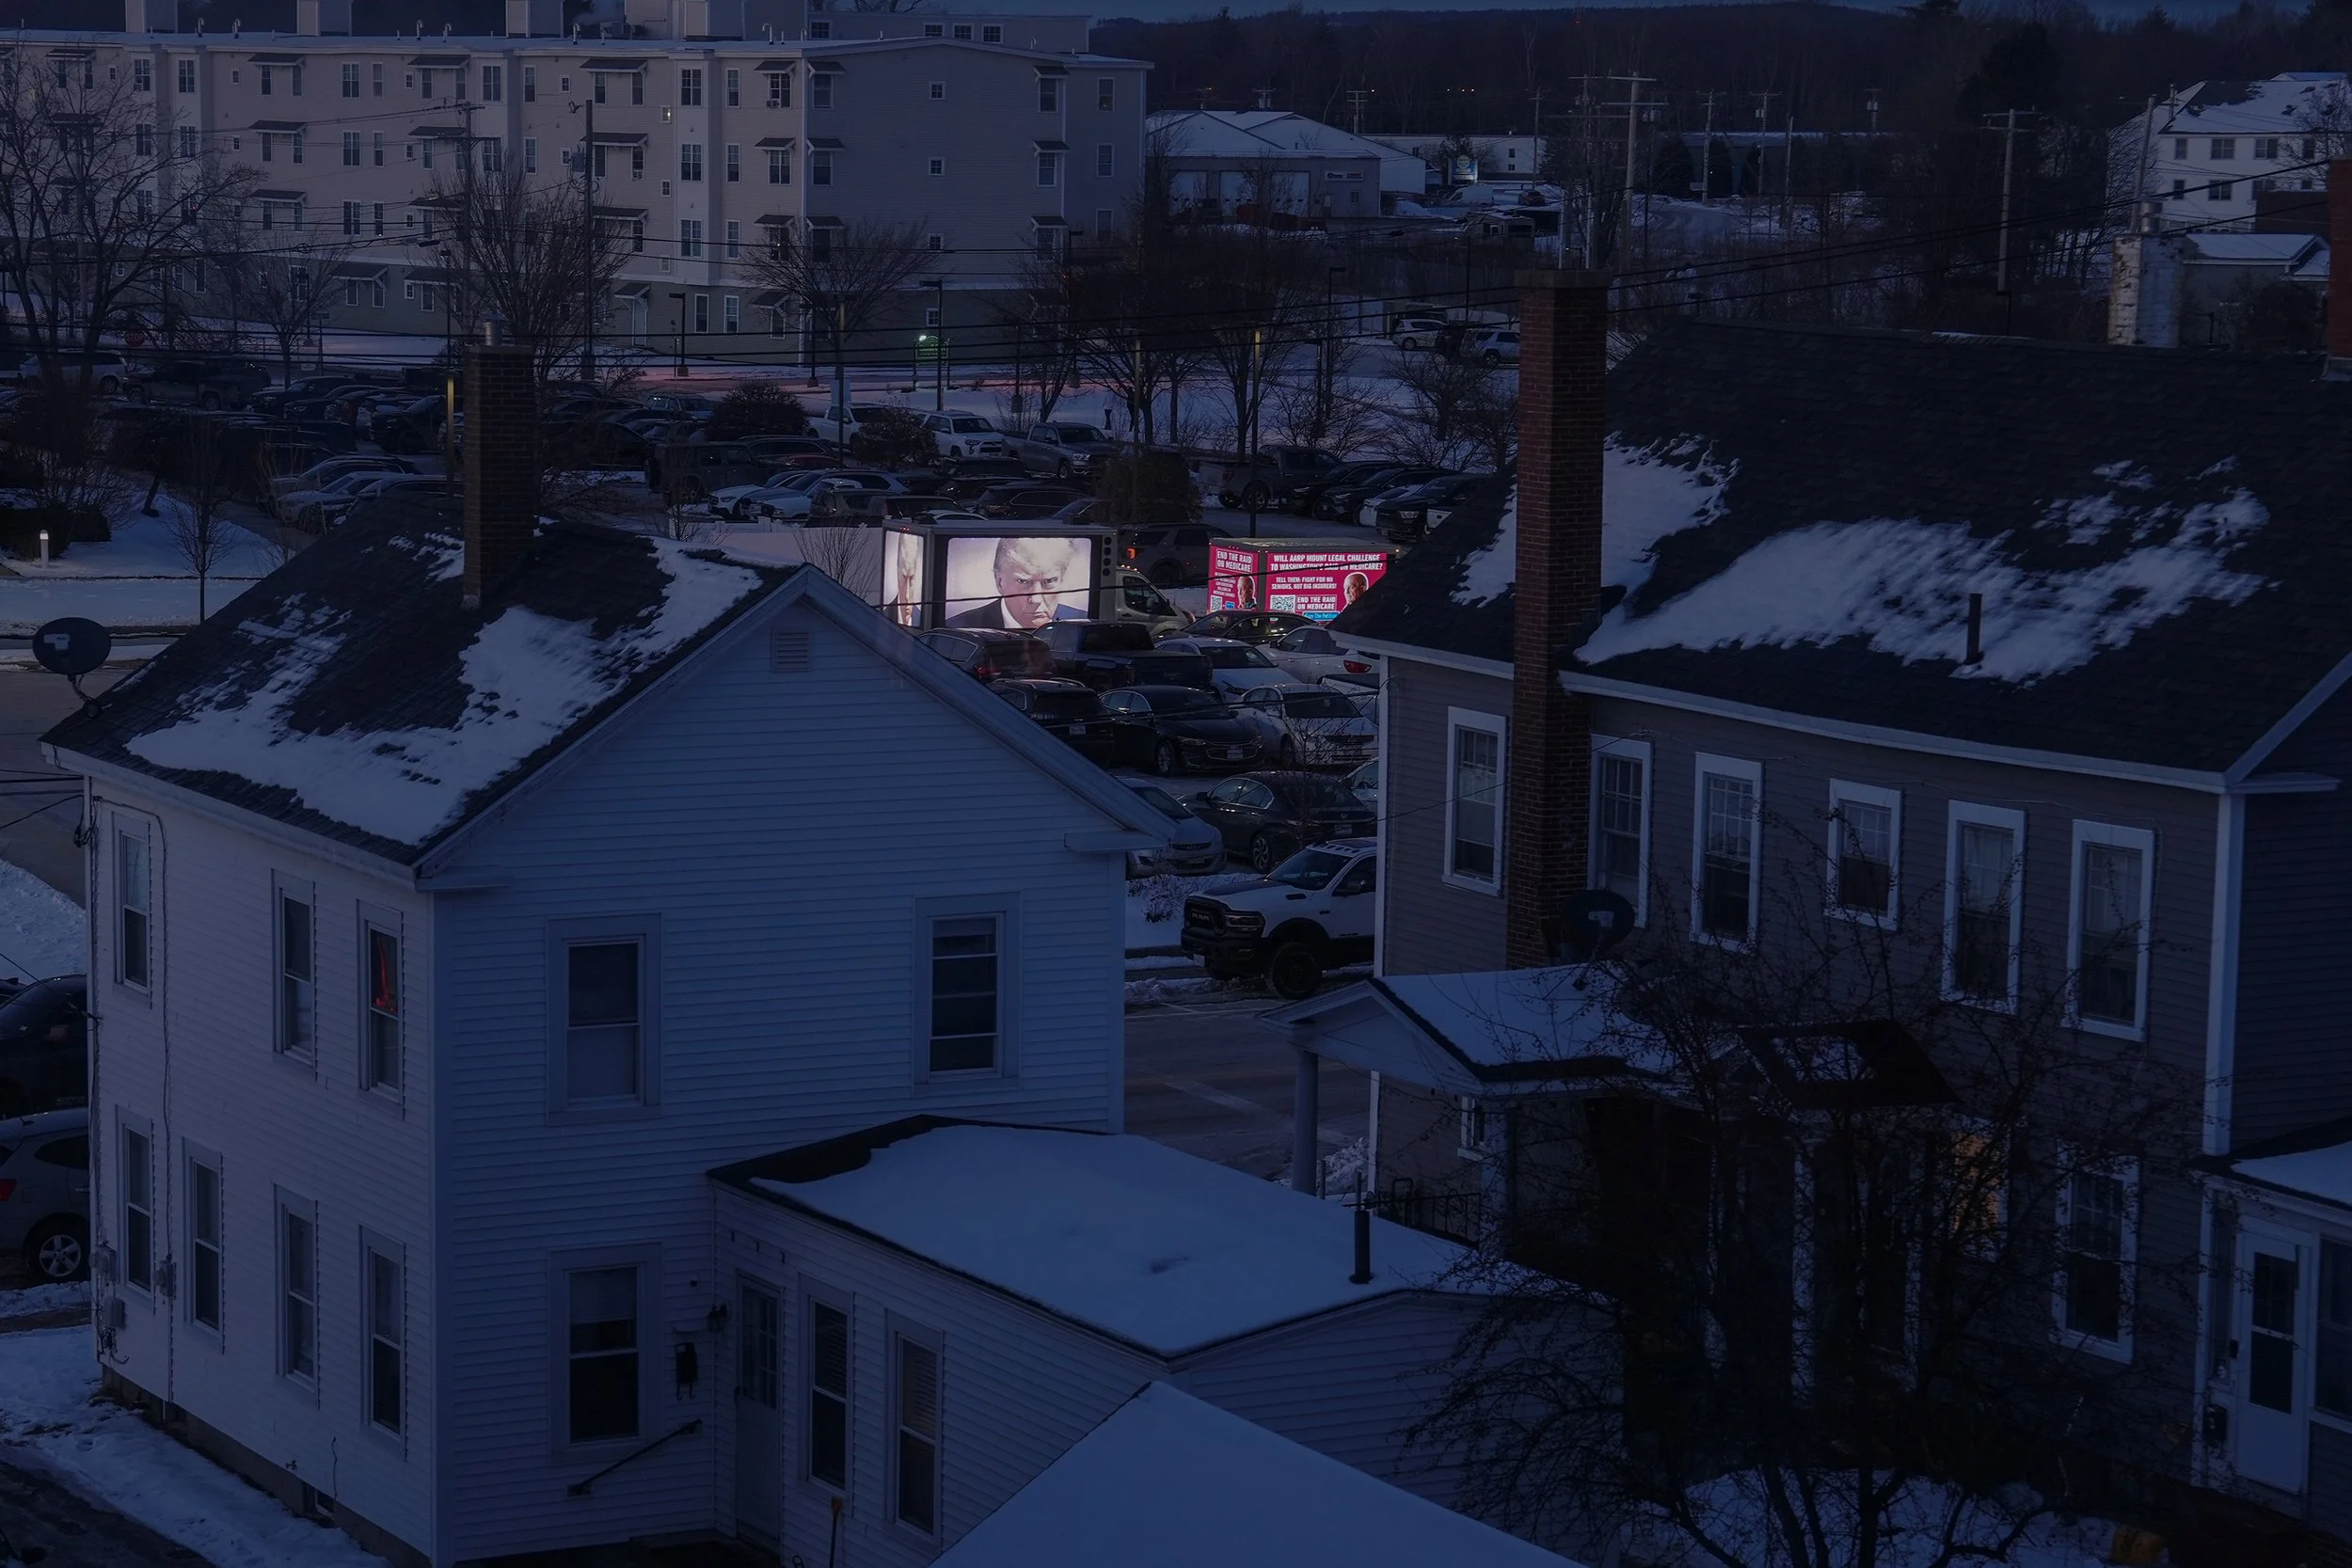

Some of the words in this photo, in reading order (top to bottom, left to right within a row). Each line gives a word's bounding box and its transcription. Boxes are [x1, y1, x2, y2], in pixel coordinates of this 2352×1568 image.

[1216, 550, 1228, 560] END
[1229, 552, 1238, 562] THE
[1239, 554, 1252, 563] RAID
[1273, 554, 1288, 562] WILL
[1289, 554, 1306, 562] AARP
[1306, 554, 1327, 562] MOUNT
[1327, 554, 1346, 562] LEGAL
[1346, 554, 1381, 562] CHALLENGE
[1216, 559, 1225, 568] ON
[1225, 561, 1251, 572] MEDICARE
[1349, 562, 1383, 571] MEDICARE?
